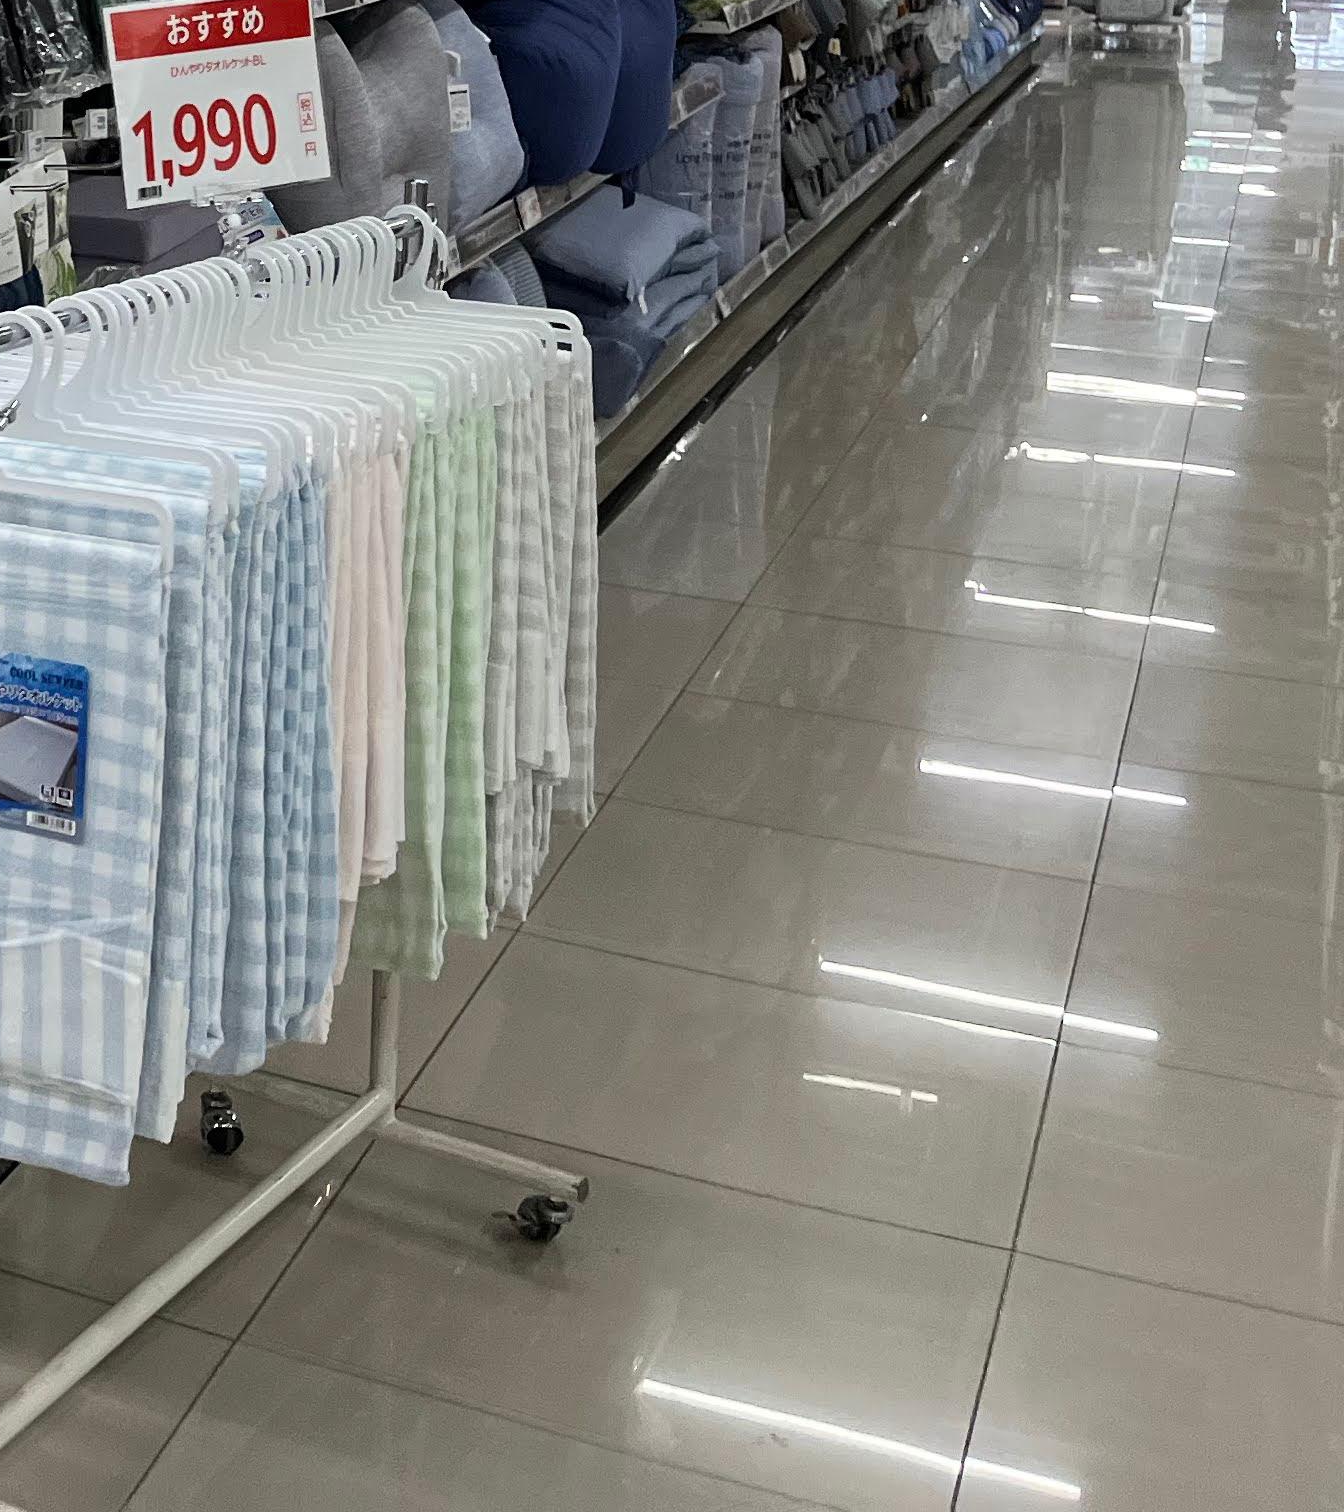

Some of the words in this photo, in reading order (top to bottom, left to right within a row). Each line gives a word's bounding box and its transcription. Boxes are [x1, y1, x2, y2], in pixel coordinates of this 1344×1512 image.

[166, 5, 265, 45] おすすめ
[132, 93, 278, 187] 1,990
